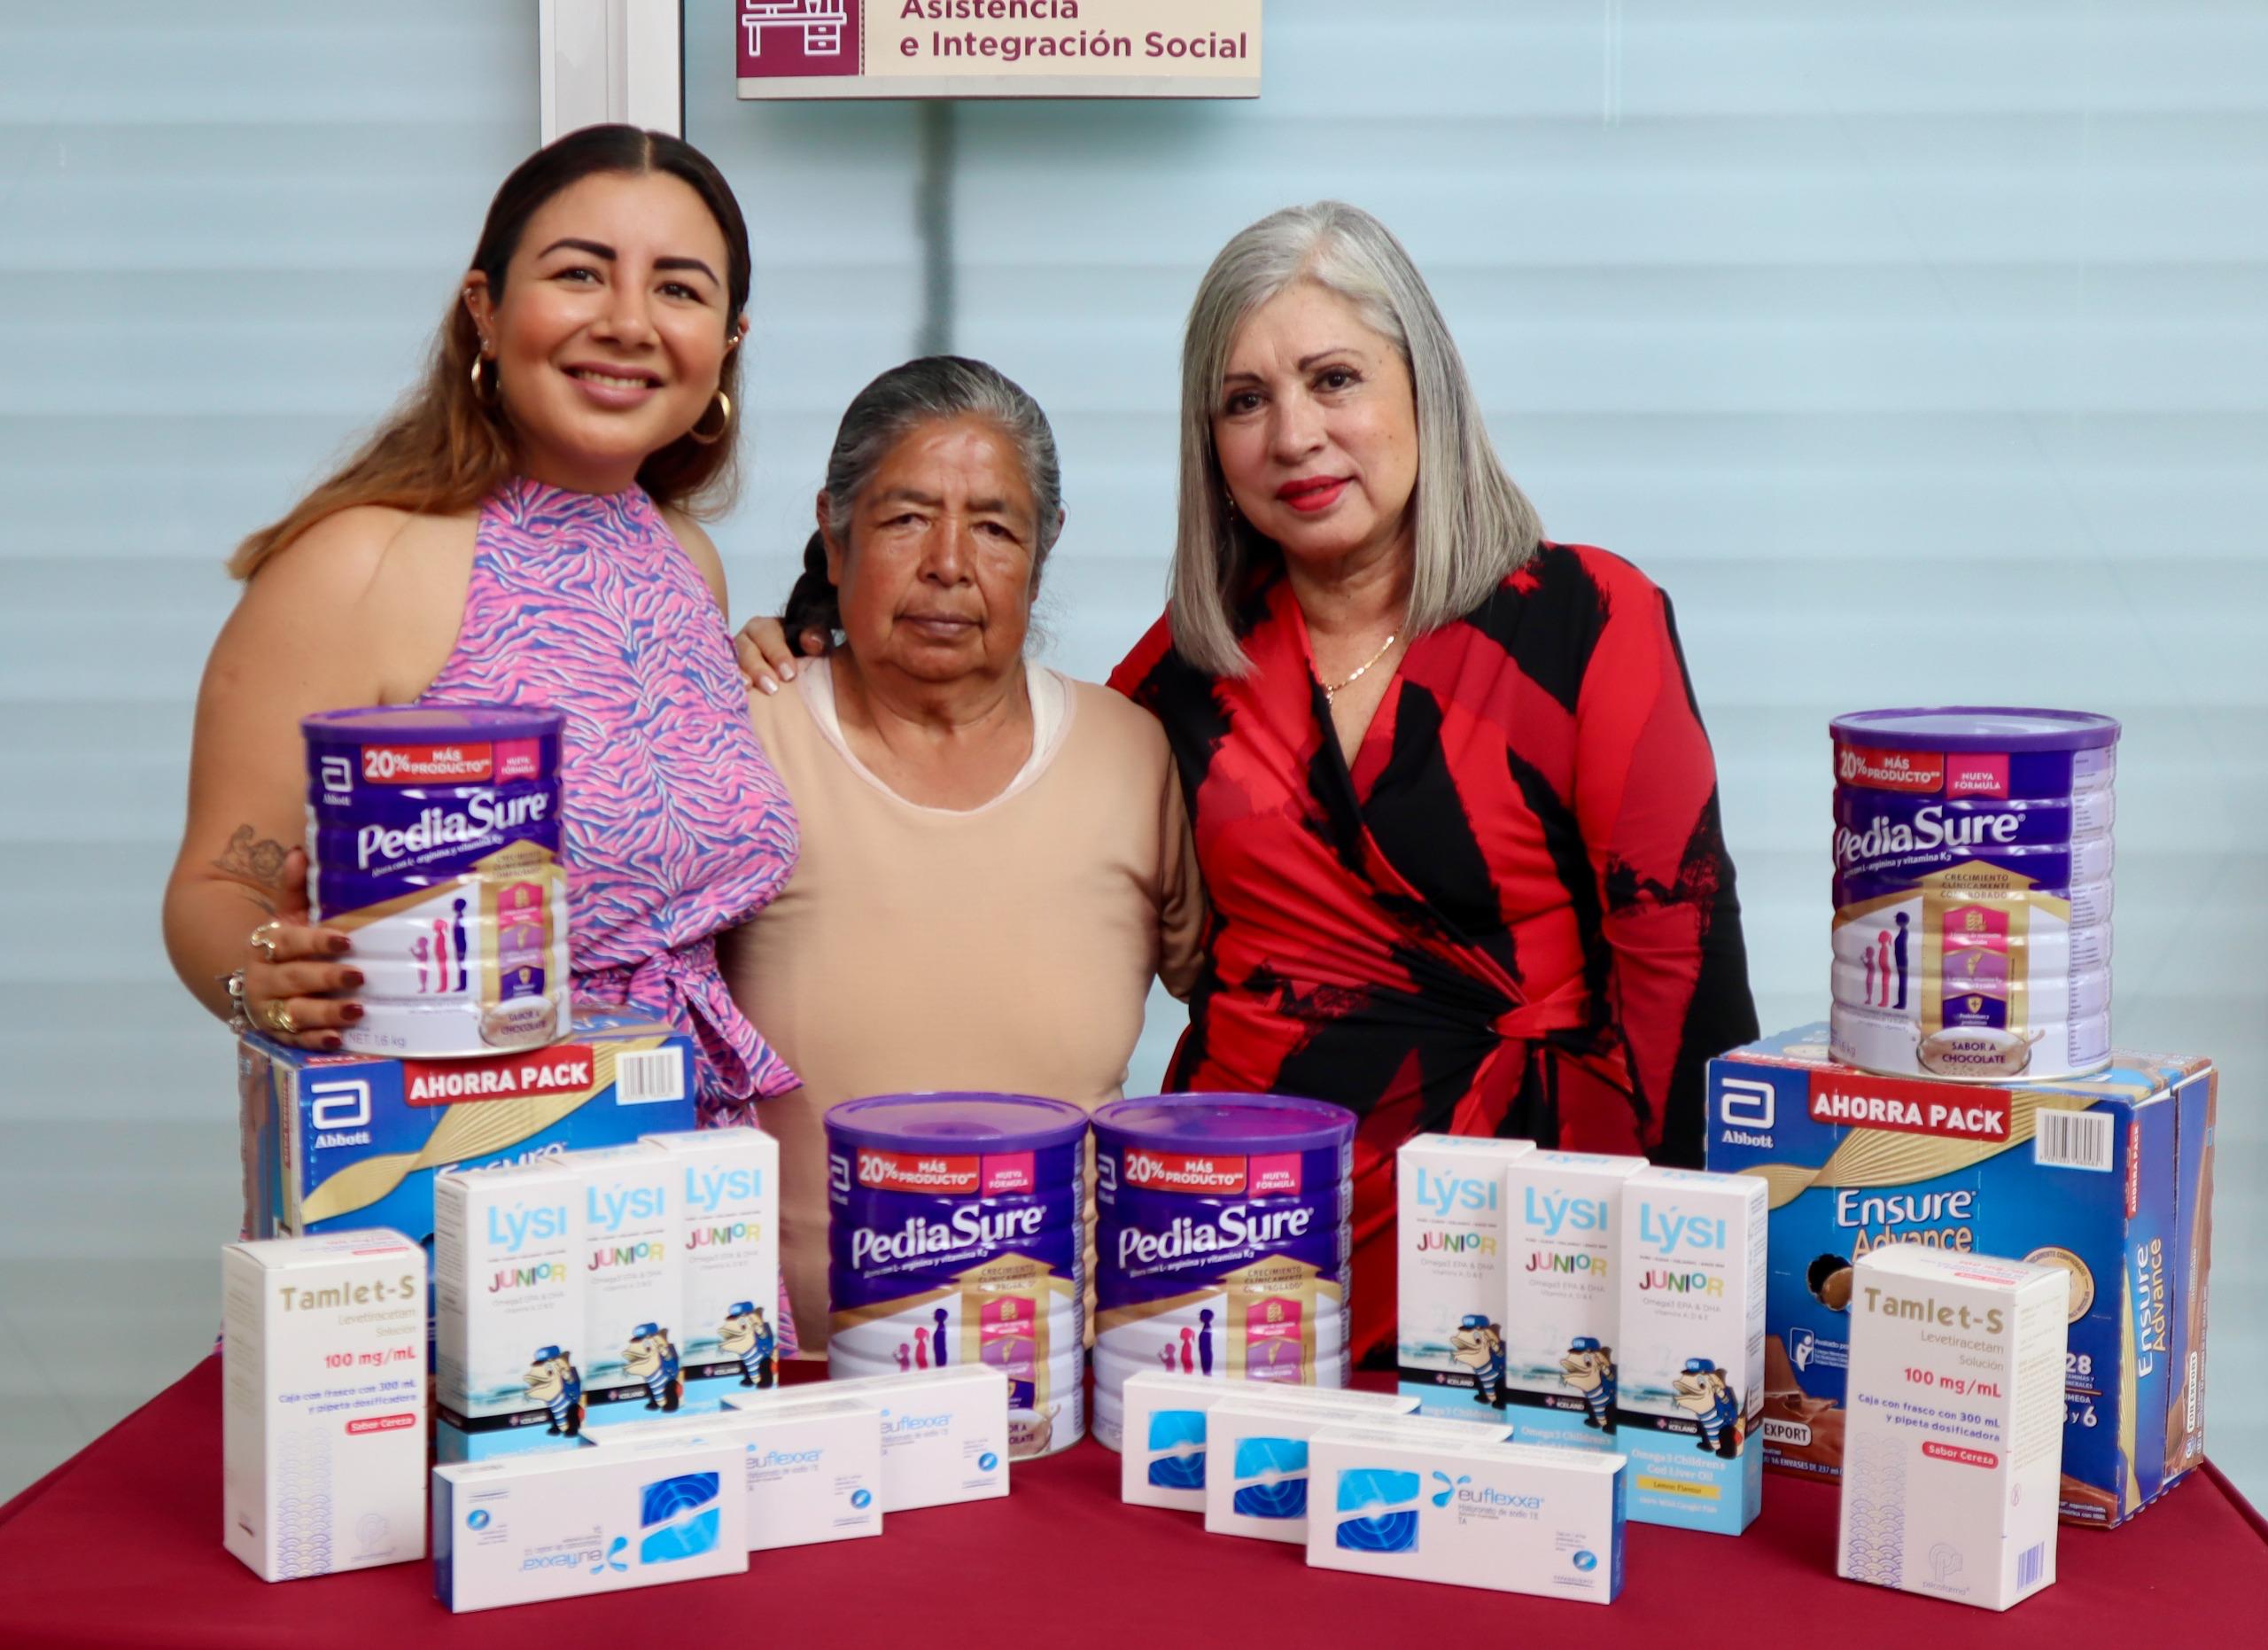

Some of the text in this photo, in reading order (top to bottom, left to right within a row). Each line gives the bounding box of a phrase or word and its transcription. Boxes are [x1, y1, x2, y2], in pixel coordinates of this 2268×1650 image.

[900, 0, 1079, 19] Asistencia
[900, 29, 1247, 61] e Integración Social
[364, 751, 410, 778] 20%
[432, 748, 462, 762] MÁS
[1841, 751, 1867, 781] 20%
[1884, 756, 1909, 769] MÁS
[1961, 772, 1993, 781] NUEVA
[1903, 853, 1939, 866] vitamina
[1945, 873, 2008, 882] CRECIMIENTO
[1952, 1042, 1996, 1052] SABOR A
[1942, 1054, 2006, 1064] CHOCOLATE
[409, 1062, 589, 1100] AHORRA PACK
[1814, 1093, 2006, 1134] AHORRA PACK
[315, 1132, 370, 1149] Abbott
[1721, 1130, 1774, 1148] Abbott
[859, 1156, 898, 1183] 20%
[919, 1160, 946, 1172] MÁS
[1126, 1155, 1165, 1183] 20%
[1185, 1159, 1213, 1172] MÁS
[1837, 1189, 1973, 1227] Ensure
[686, 1222, 761, 1250] JUNIOR
[1418, 1231, 1496, 1256] JUNIOR
[588, 1241, 664, 1272] JUNIOR
[1526, 1251, 1607, 1277] JUNIOR
[489, 1263, 567, 1294] JUNIOR
[1639, 1269, 1725, 1298] JUNIOR
[280, 1275, 415, 1311] Tamlet-S
[2151, 1238, 2165, 1351] Advance
[1703, 1303, 1721, 1312] DHA
[1865, 1287, 2004, 1335] Tamlet-S
[2138, 1244, 2153, 1378] Ensure
[1921, 1329, 2004, 1355] Levetiracetam
[325, 1346, 416, 1368] 100 mg/mL
[1959, 1355, 2004, 1372] Solución
[2066, 1353, 2092, 1374] 28
[1447, 1378, 1474, 1387] ICELAND
[1905, 1367, 2001, 1398] 100 mg/mL
[279, 1394, 300, 1404] Caja
[1557, 1401, 1584, 1411] ICELAND
[1858, 1393, 2000, 1428] Caja con frasco con 300 mL
[2072, 1405, 2098, 1428] y 6
[1668, 1424, 1697, 1434] ICELAND
[1765, 1423, 1807, 1442] EXPORT
[1886, 1413, 2000, 1443] y pipeta dosificadora
[1928, 1444, 1994, 1466] Sabor Cereza
[1458, 1488, 1542, 1510] euflexxa
